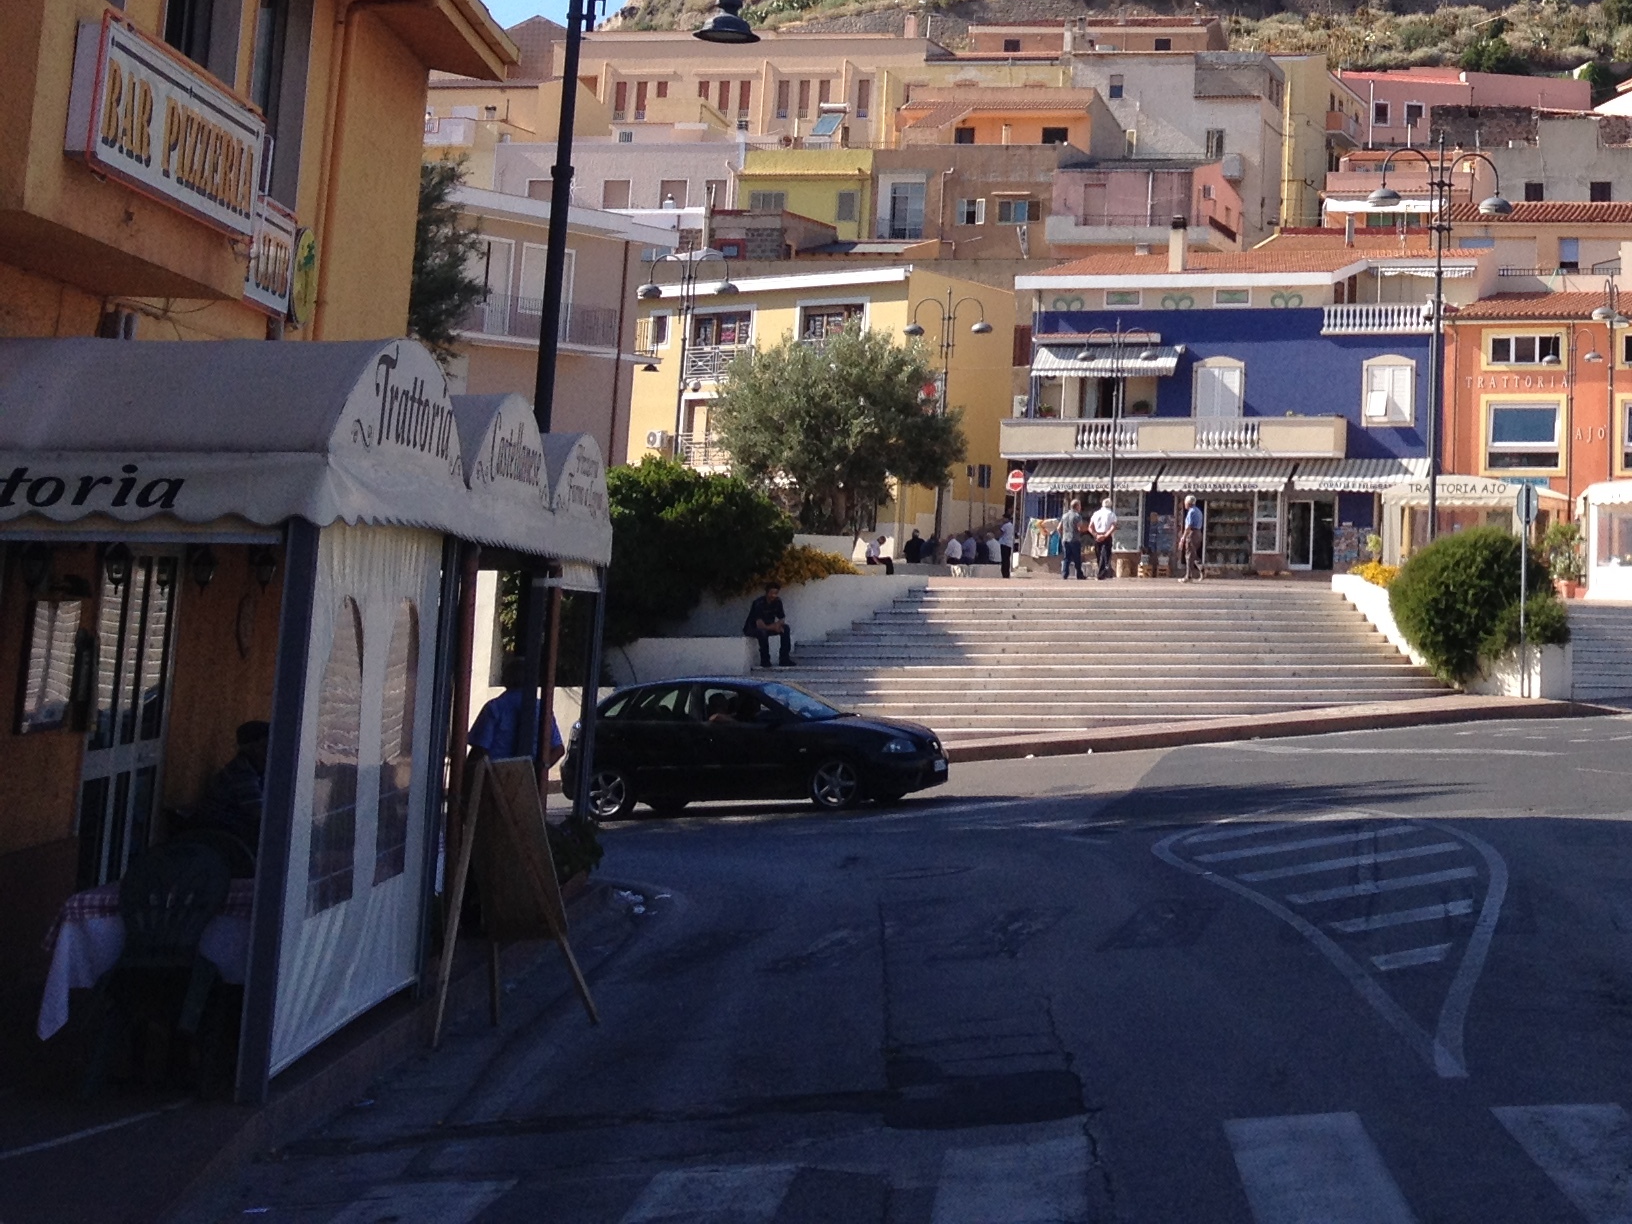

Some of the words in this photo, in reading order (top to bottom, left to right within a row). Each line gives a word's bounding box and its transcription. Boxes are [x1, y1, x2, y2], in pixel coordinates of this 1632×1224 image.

[101, 57, 152, 168] BAR
[161, 96, 253, 220] PIZZERIA
[375, 344, 453, 460] Trattoria
[1465, 376, 1569, 388] TRATTORIA
